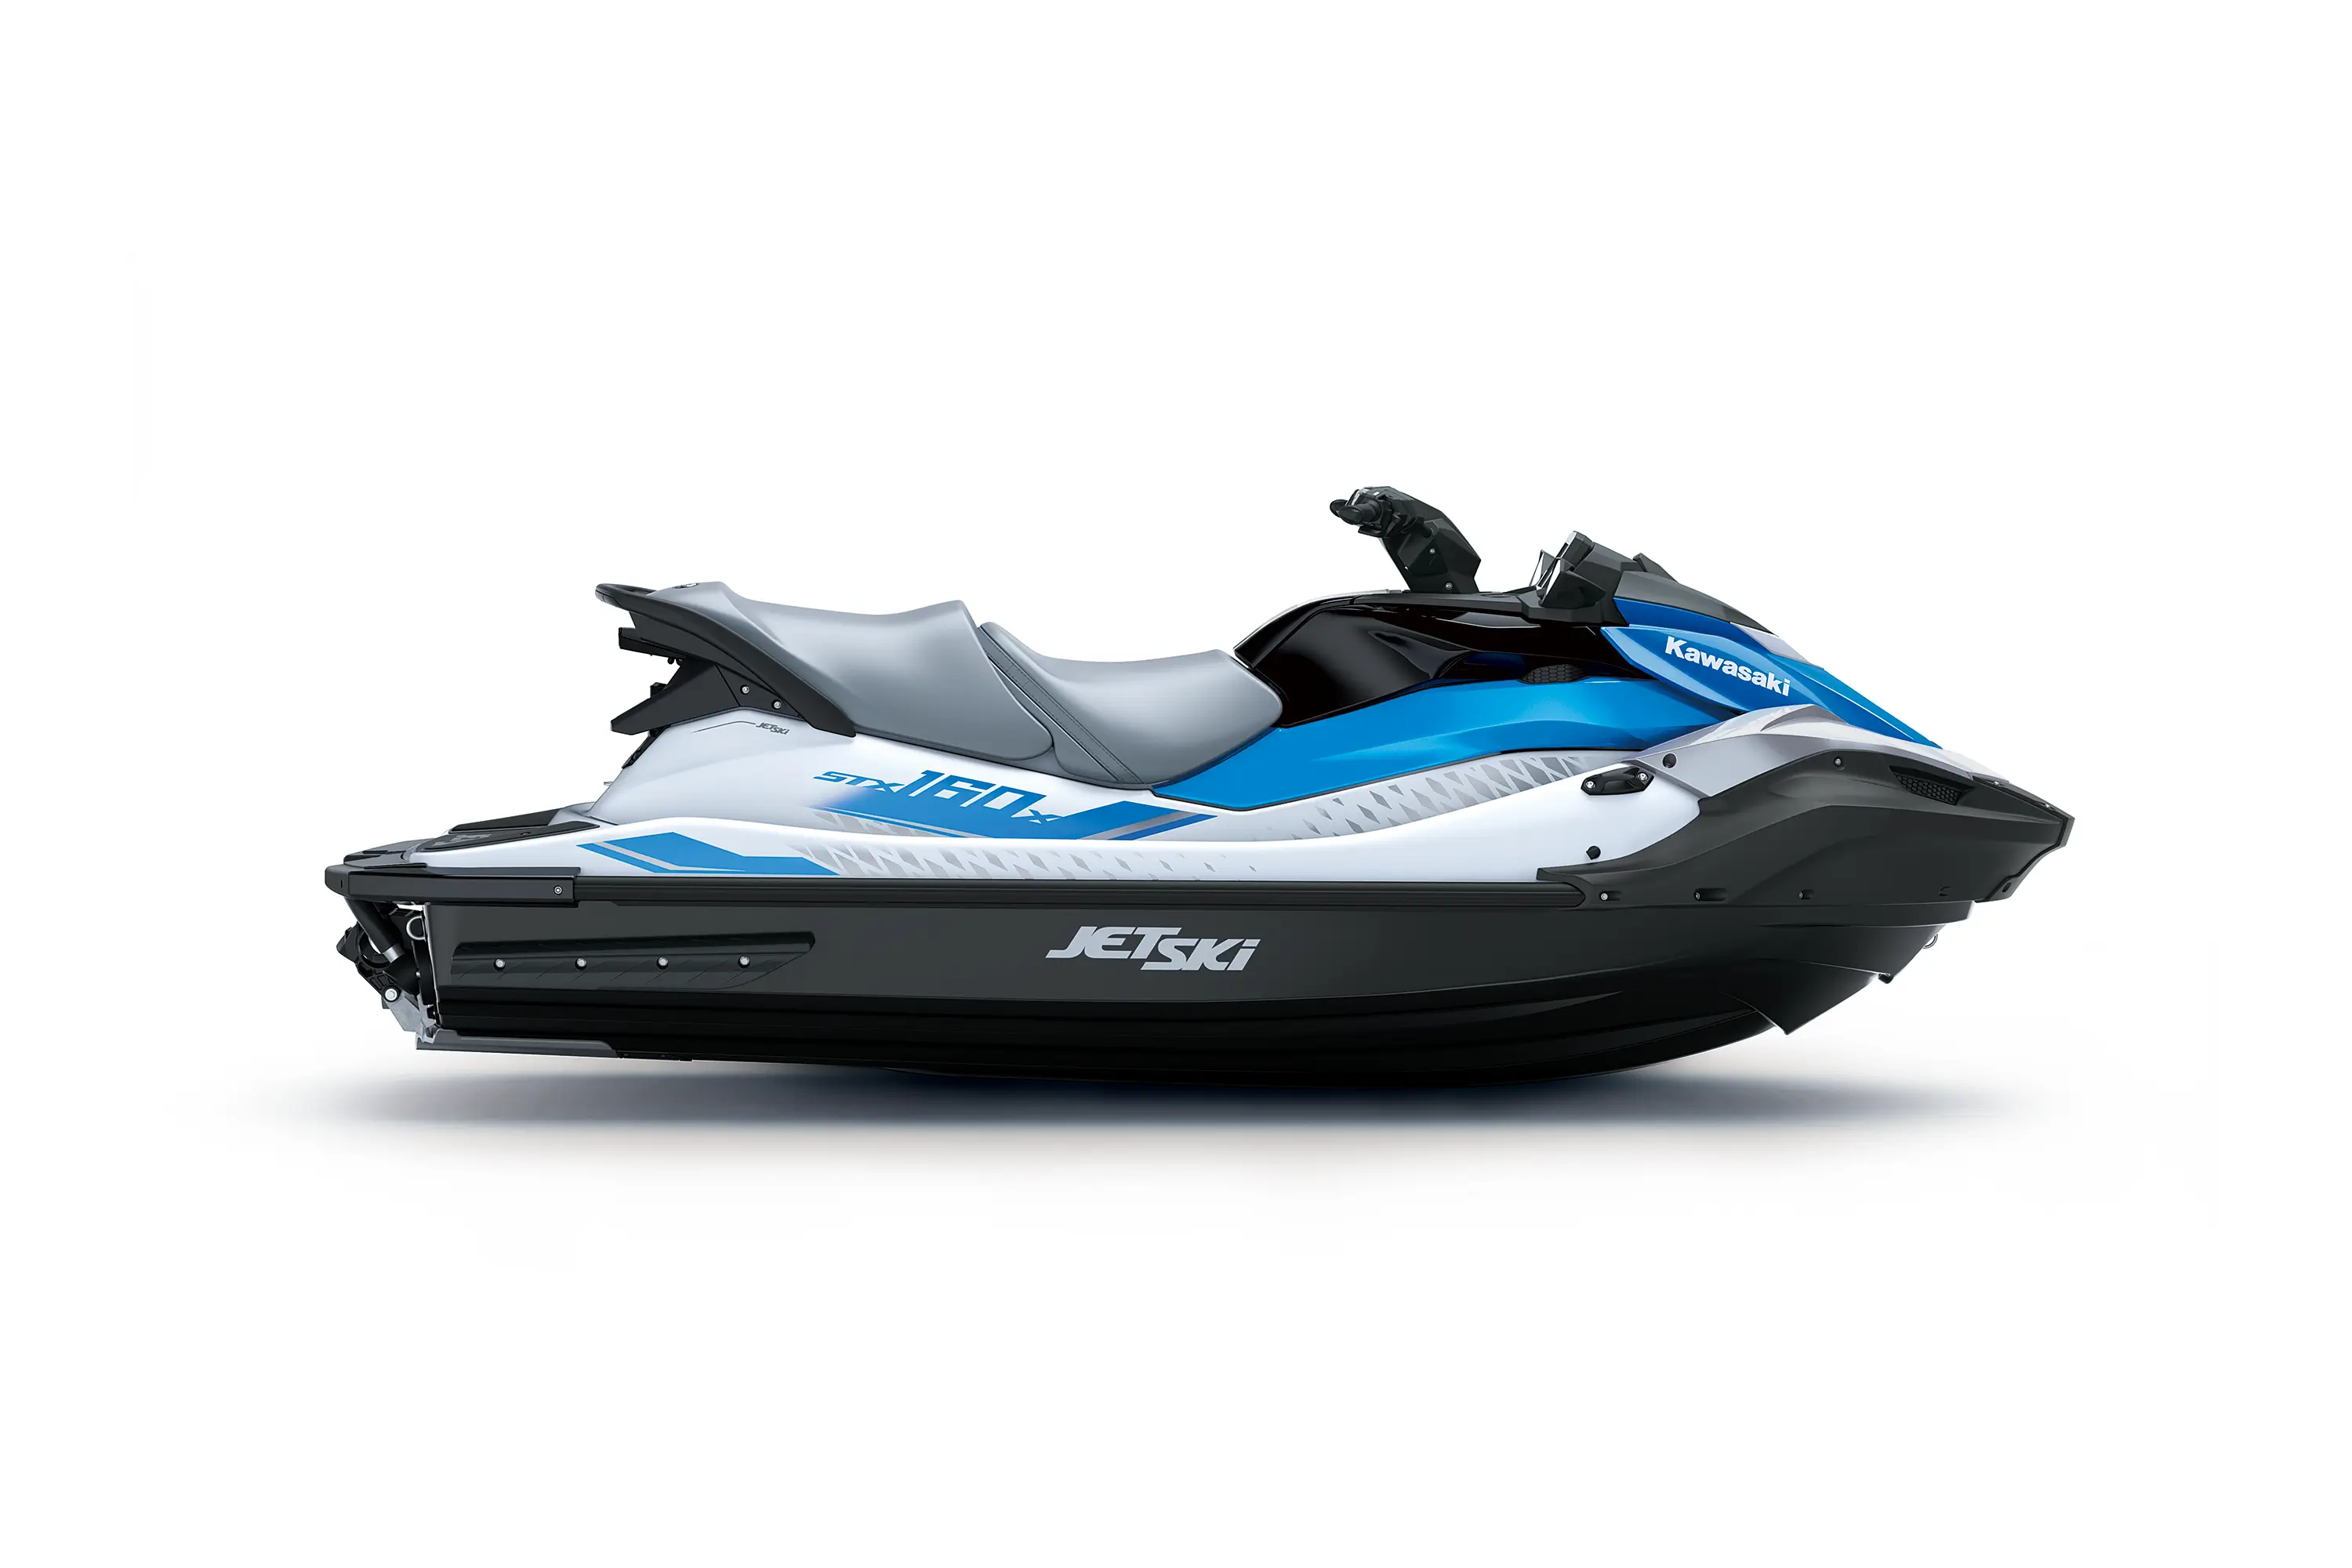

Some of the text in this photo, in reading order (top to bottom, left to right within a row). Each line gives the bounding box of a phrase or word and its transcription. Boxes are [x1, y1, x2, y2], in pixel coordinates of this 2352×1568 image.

[1664, 635, 1791, 697] Kawasaki
[813, 771, 905, 793] STX
[903, 769, 1047, 817] 160
